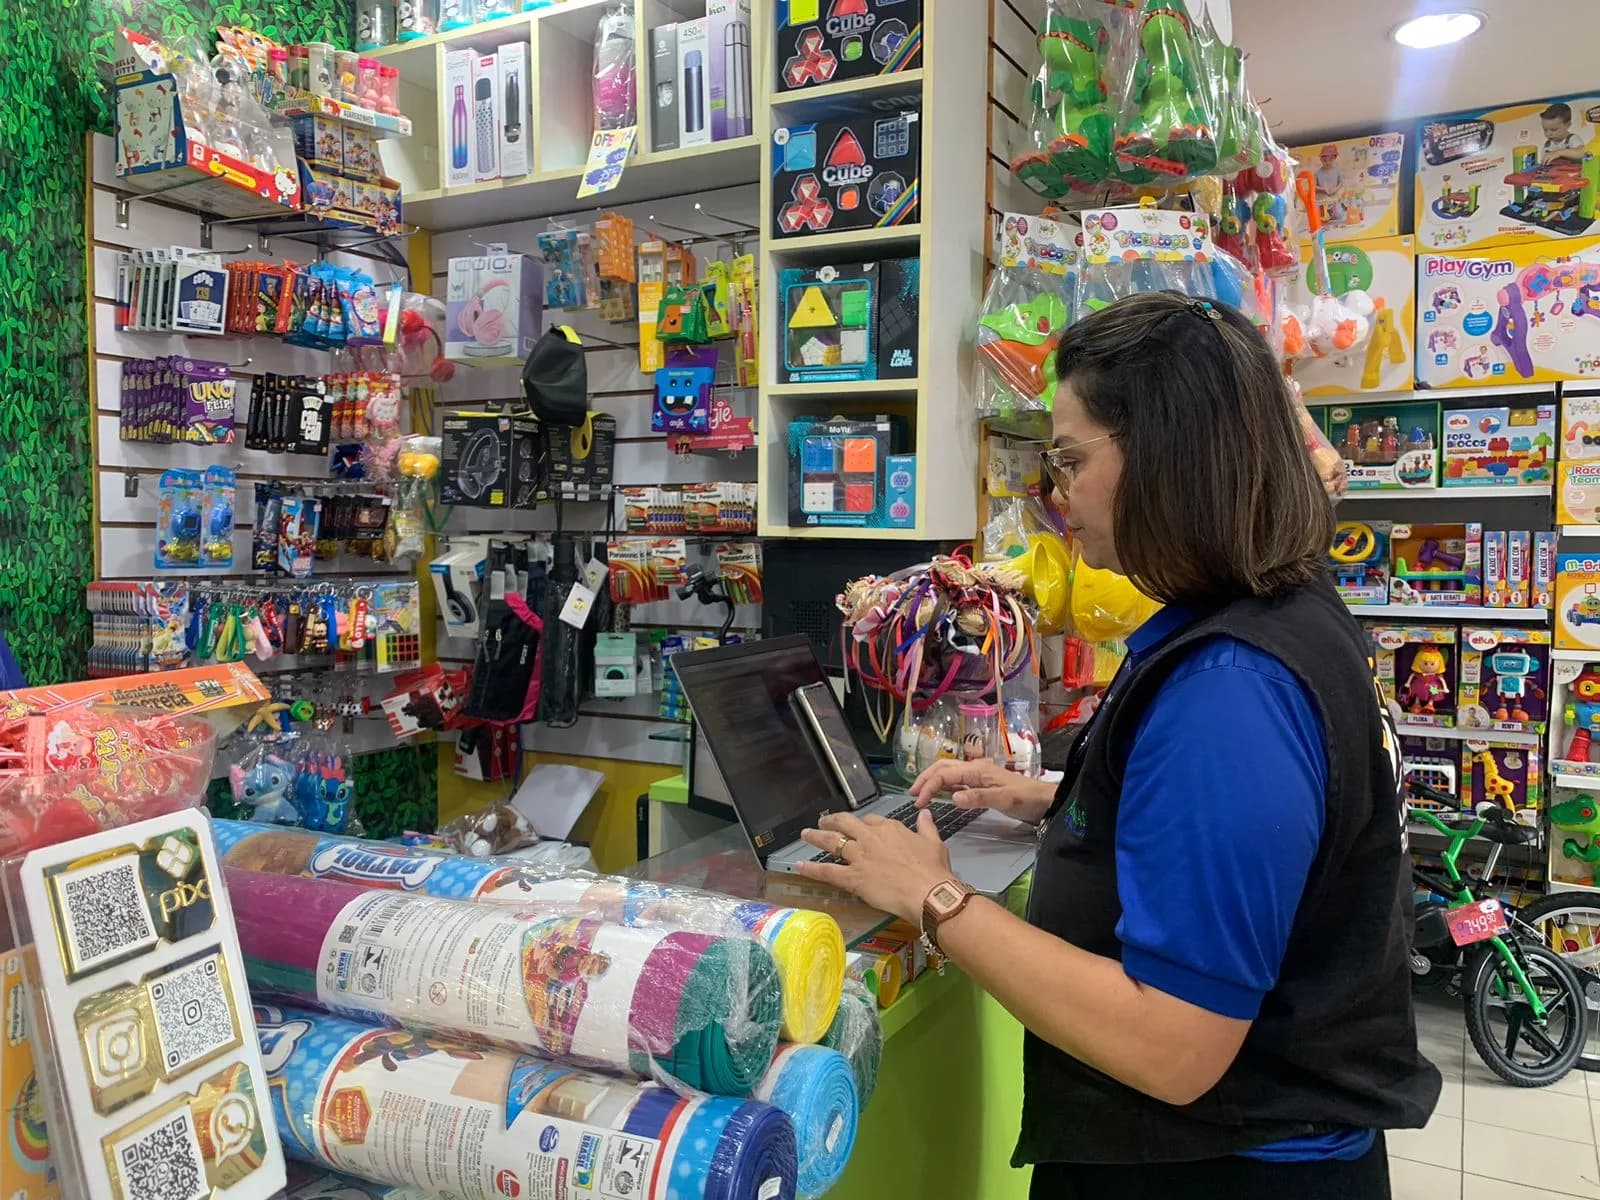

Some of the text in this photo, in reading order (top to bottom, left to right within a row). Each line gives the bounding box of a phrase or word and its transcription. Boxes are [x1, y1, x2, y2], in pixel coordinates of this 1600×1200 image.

[826, 13, 876, 34] Cube
[822, 163, 874, 183] Cube
[1428, 259, 1512, 279] Play Gym
[191, 381, 234, 402] UNO
[1447, 433, 1472, 441] FOFO
[1381, 636, 1402, 644] elka
[1472, 635, 1495, 645] elka
[333, 848, 427, 874] PATROL
[159, 877, 210, 923] pix
[576, 1135, 592, 1168] BRASIL
[502, 1173, 511, 1198] LIDER
